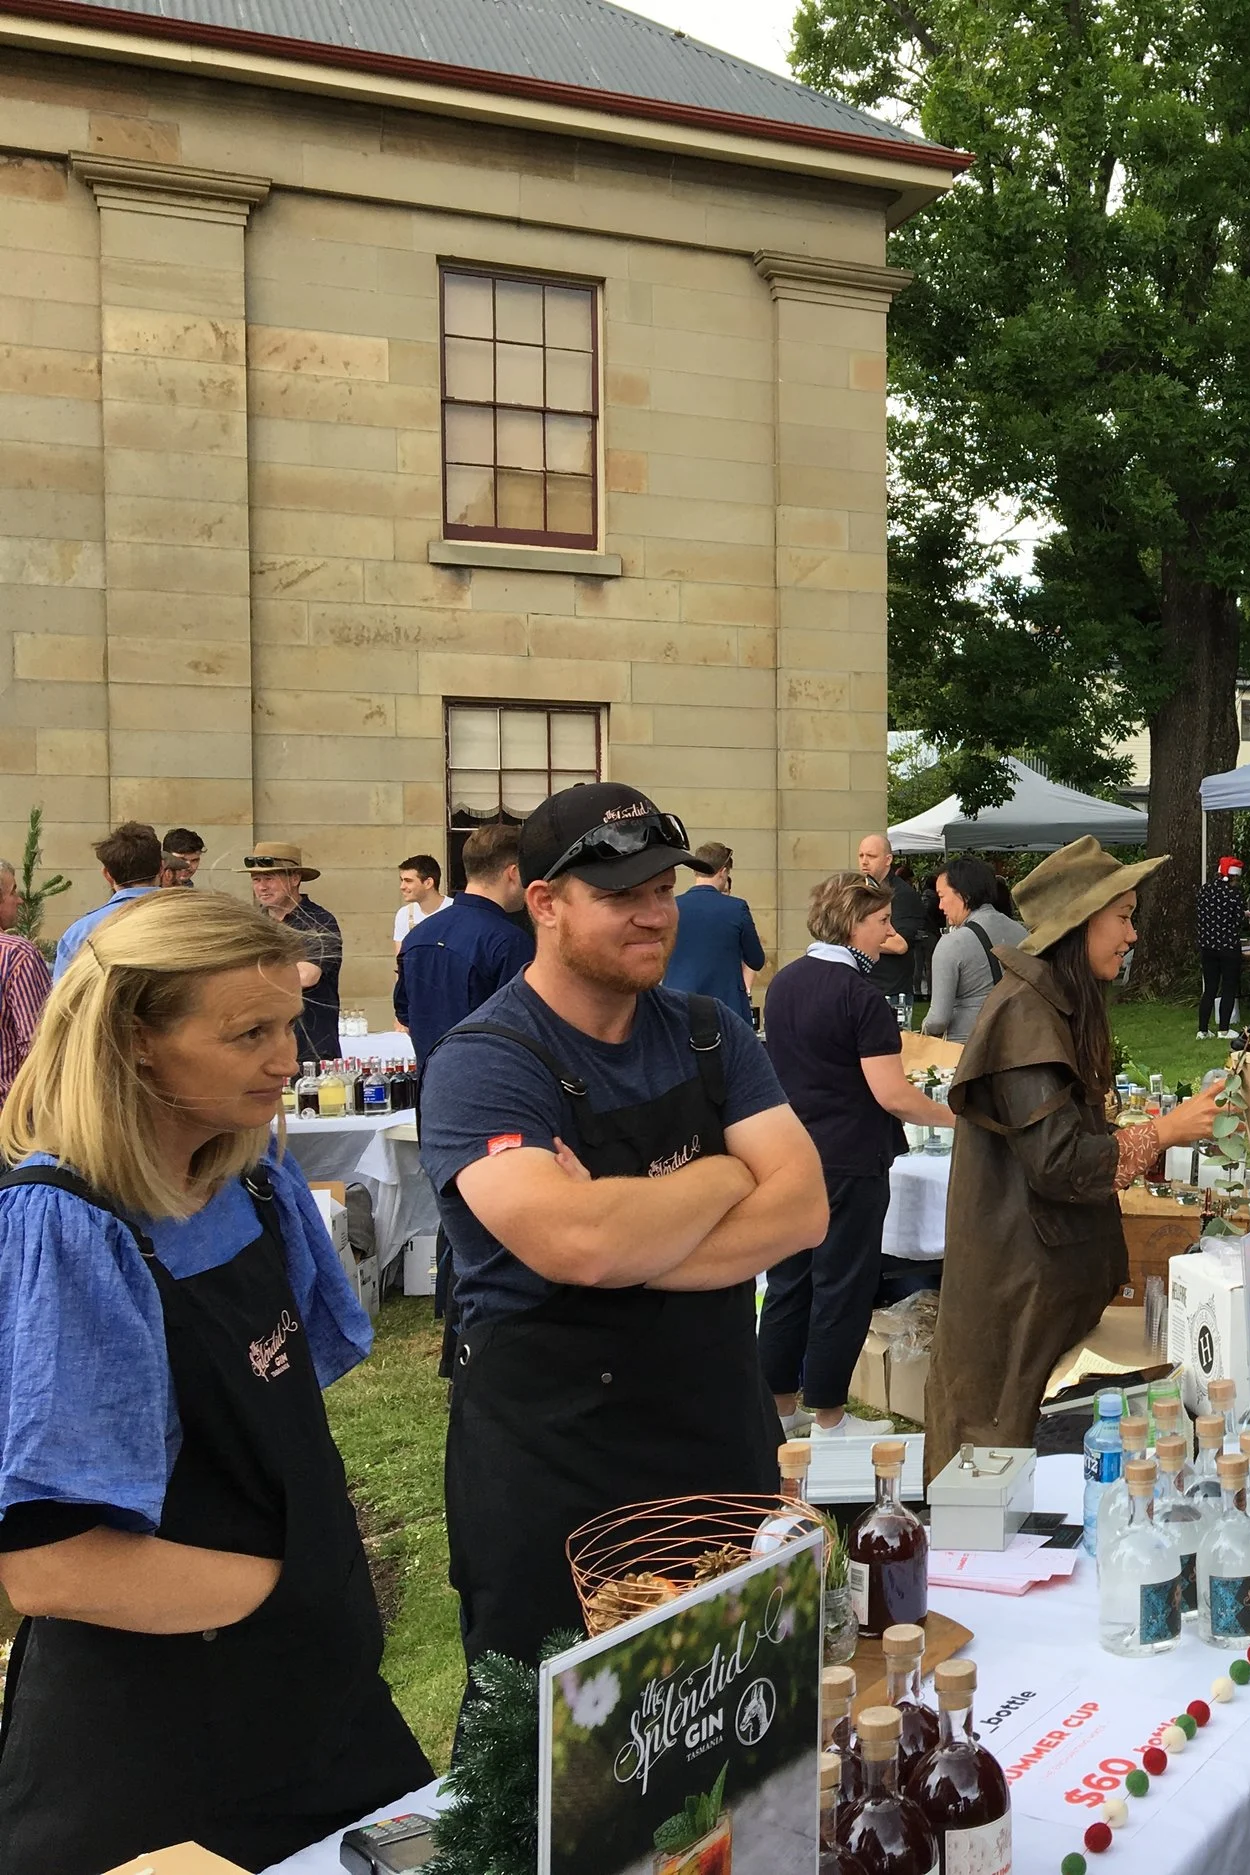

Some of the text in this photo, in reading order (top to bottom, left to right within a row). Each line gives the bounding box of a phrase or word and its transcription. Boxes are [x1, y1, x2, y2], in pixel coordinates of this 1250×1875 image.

[614, 1586, 788, 1796] Splendid
[685, 1707, 724, 1749] GIN
[685, 1735, 724, 1762] TASMANIA
[1006, 1730, 1072, 1787] UMMER
[1062, 1702, 1100, 1728] CUP
[1064, 1757, 1138, 1809] $60
